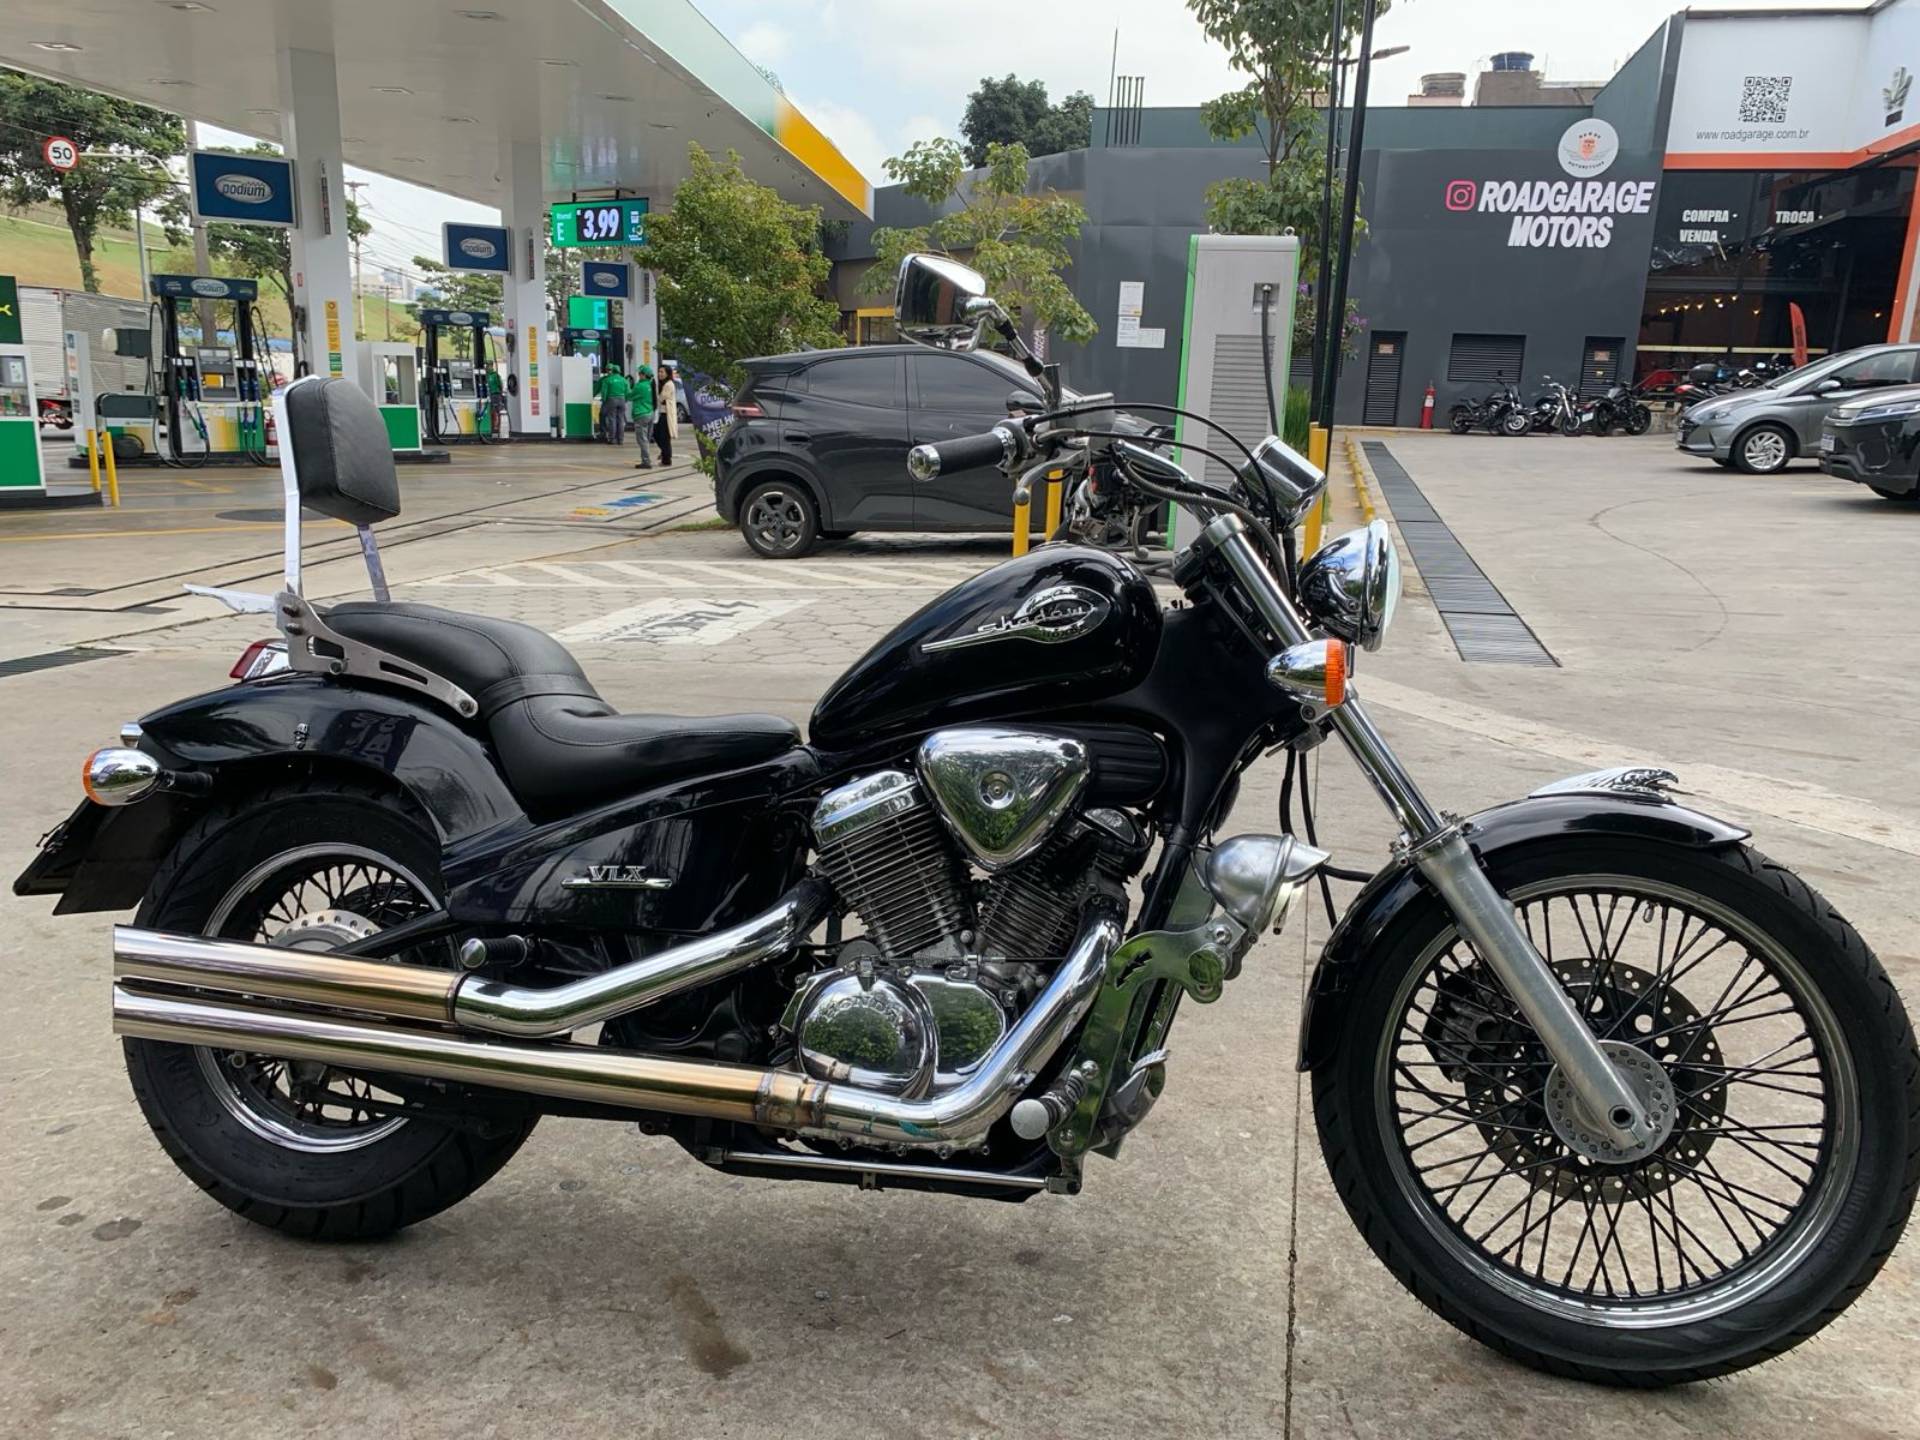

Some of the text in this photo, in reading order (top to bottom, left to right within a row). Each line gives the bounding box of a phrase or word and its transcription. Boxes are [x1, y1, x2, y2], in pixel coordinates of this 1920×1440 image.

[52, 146, 73, 160] 50
[222, 183, 266, 197] podium
[1478, 181, 1656, 213] ROADGARAGE
[583, 207, 619, 240] 3,99
[1682, 209, 1730, 223] COMPRA
[1775, 210, 1815, 224] TROCA
[556, 222, 565, 241] E
[1507, 215, 1614, 248] MOTORS
[1679, 229, 1718, 243] VENDA
[588, 865, 646, 881] VLX
